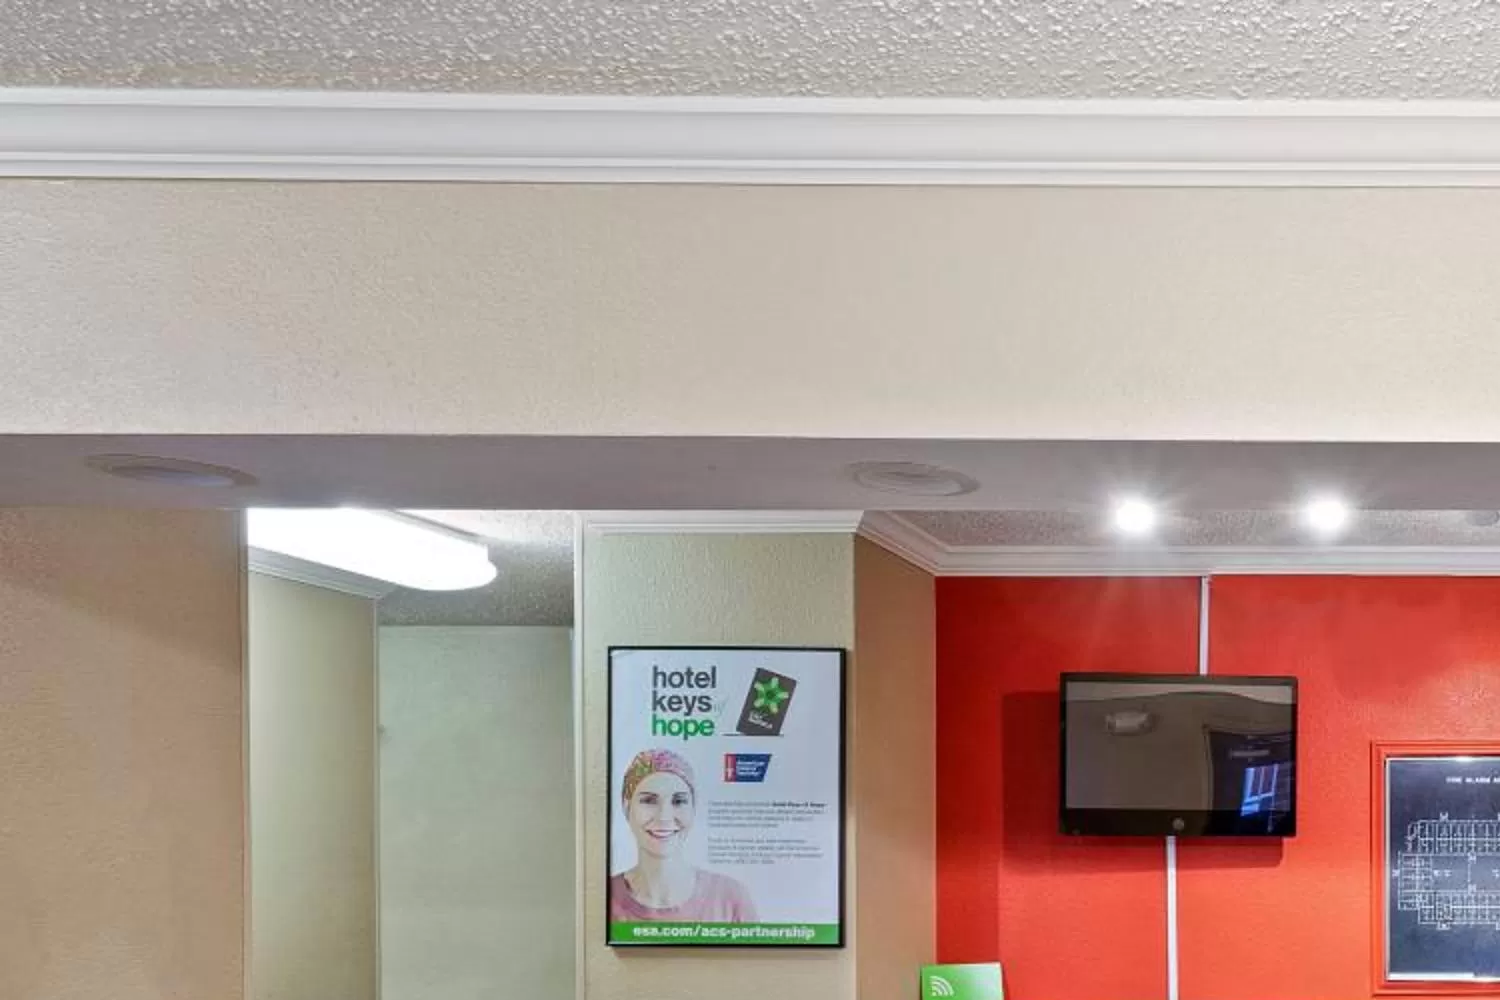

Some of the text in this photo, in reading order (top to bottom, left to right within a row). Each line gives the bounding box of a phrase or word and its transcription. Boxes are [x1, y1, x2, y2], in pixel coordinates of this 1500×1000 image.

[652, 665, 717, 689] hotel
[652, 690, 712, 716] keys
[652, 713, 715, 740] hope
